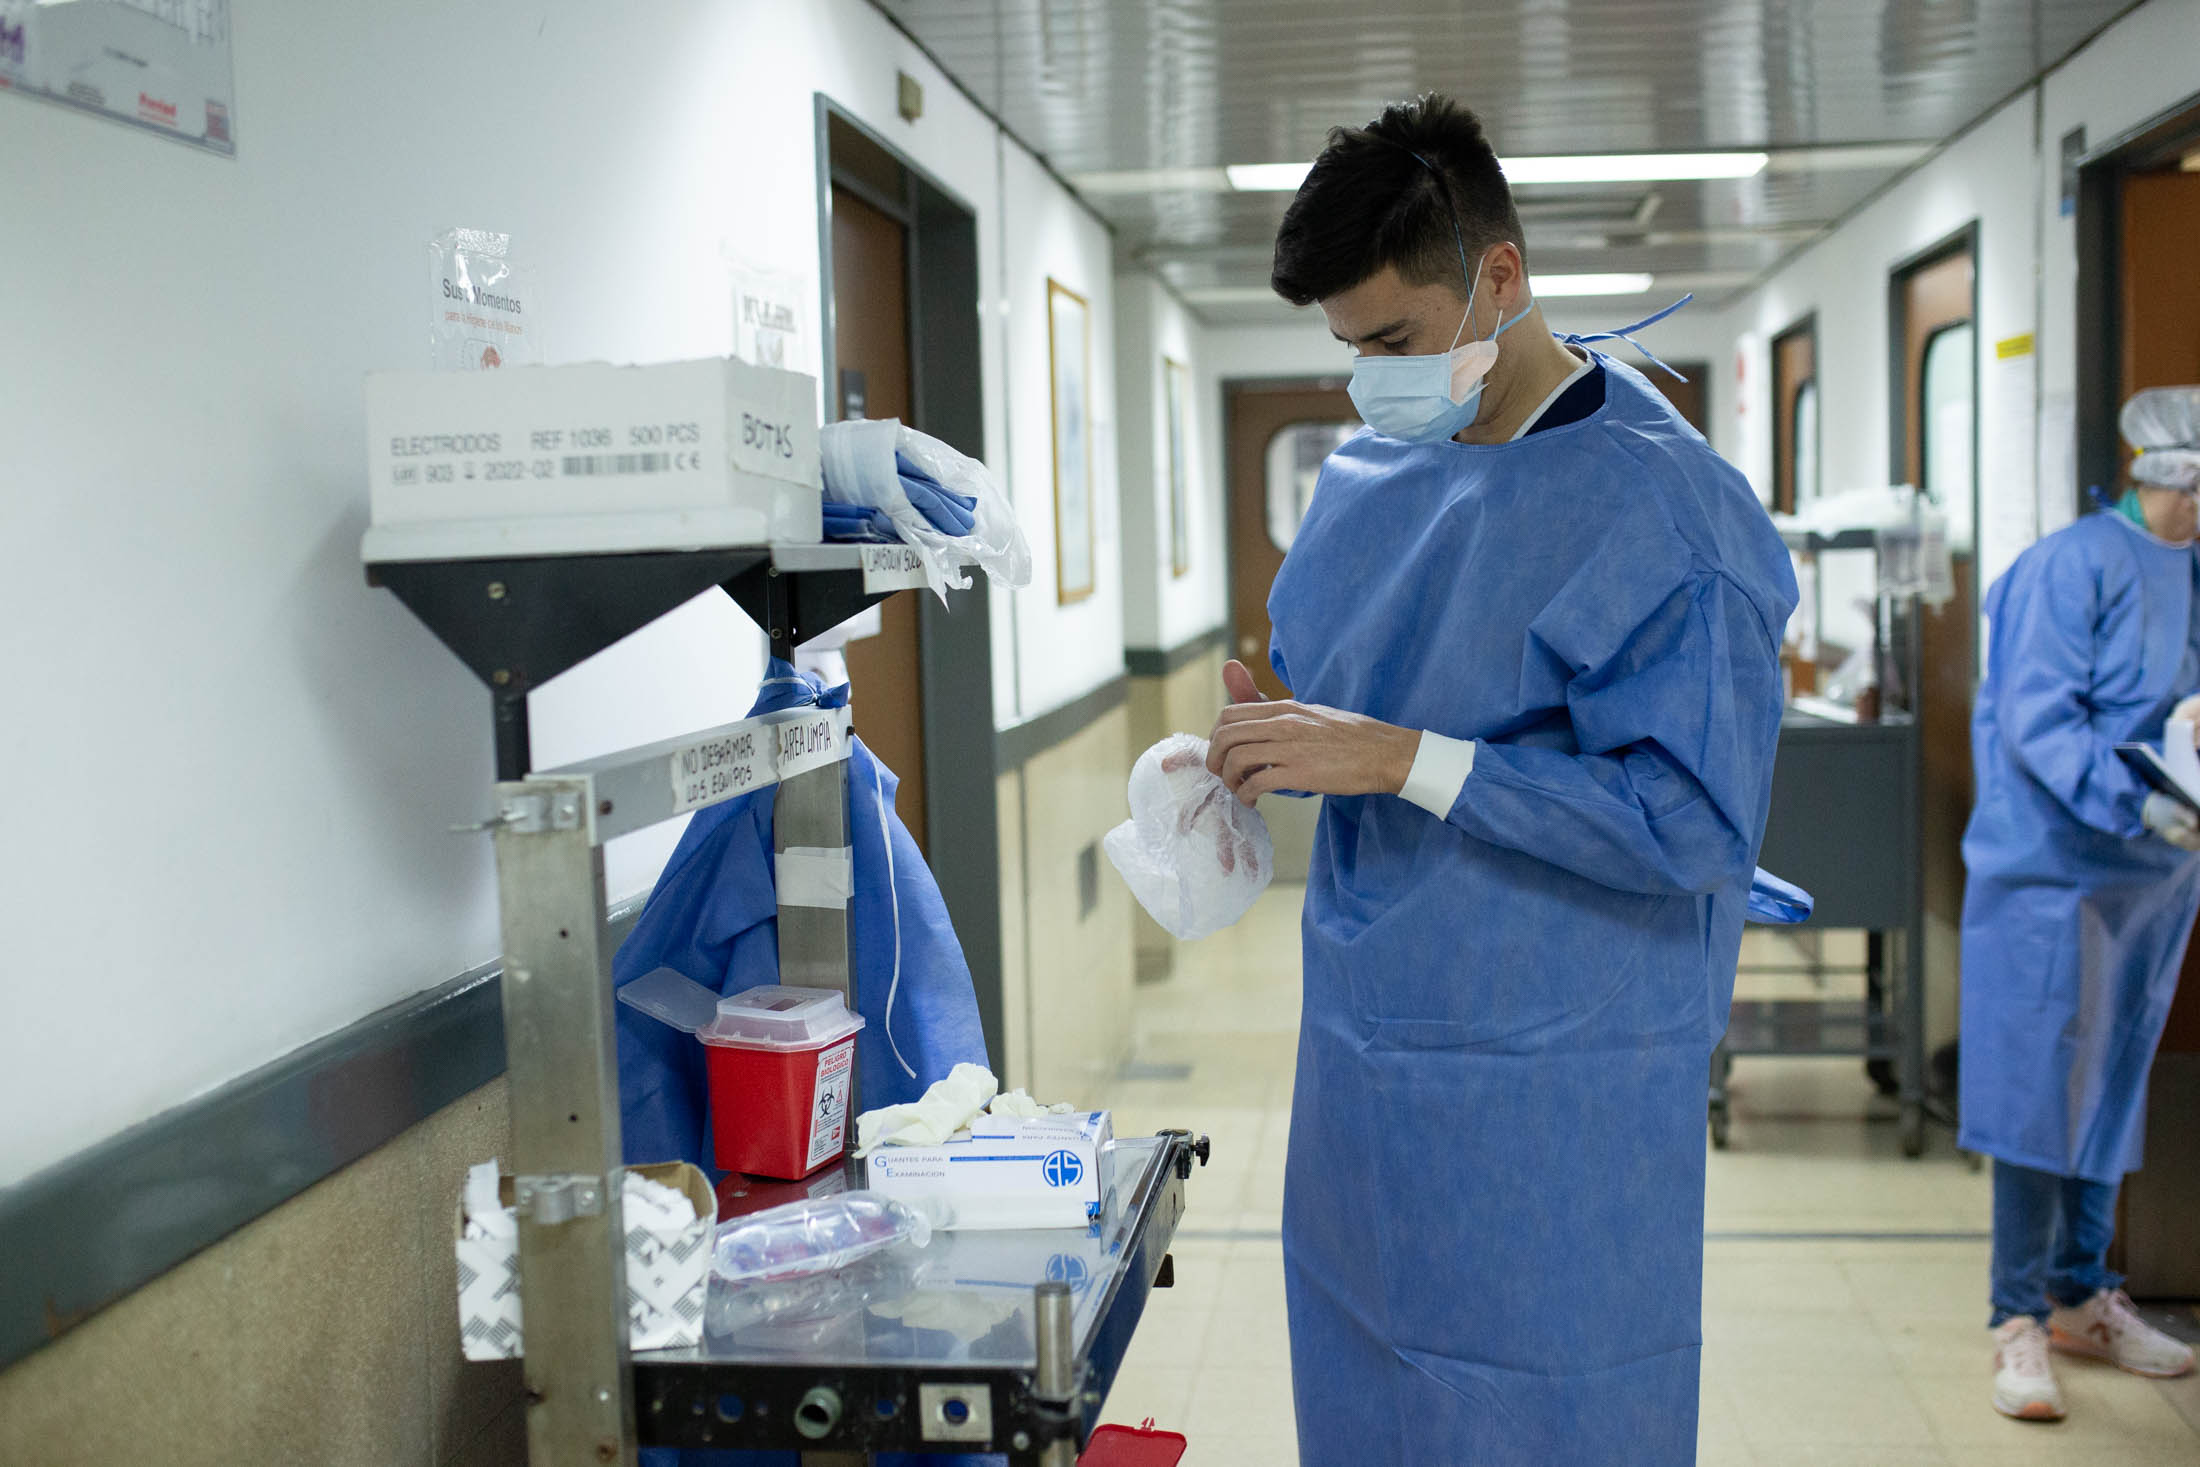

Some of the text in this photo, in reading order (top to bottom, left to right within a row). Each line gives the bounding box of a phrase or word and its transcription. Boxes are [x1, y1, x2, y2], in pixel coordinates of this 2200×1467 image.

[442, 278, 463, 301] Sus
[391, 431, 502, 457] ELECTRODOS
[531, 430, 563, 450] REF
[629, 425, 663, 446] 500
[666, 422, 701, 444] PCS
[743, 412, 793, 459] BOTAS
[484, 459, 555, 481] 2022-02
[783, 725, 805, 766] AREA
[712, 765, 753, 795] EQUIPOS
[820, 1058, 849, 1077] BIOLOGICO
[824, 1051, 847, 1067] PELIGRO
[874, 1155, 944, 1168] GUANTES PARA
[886, 1168, 945, 1177] EXAMINACION
